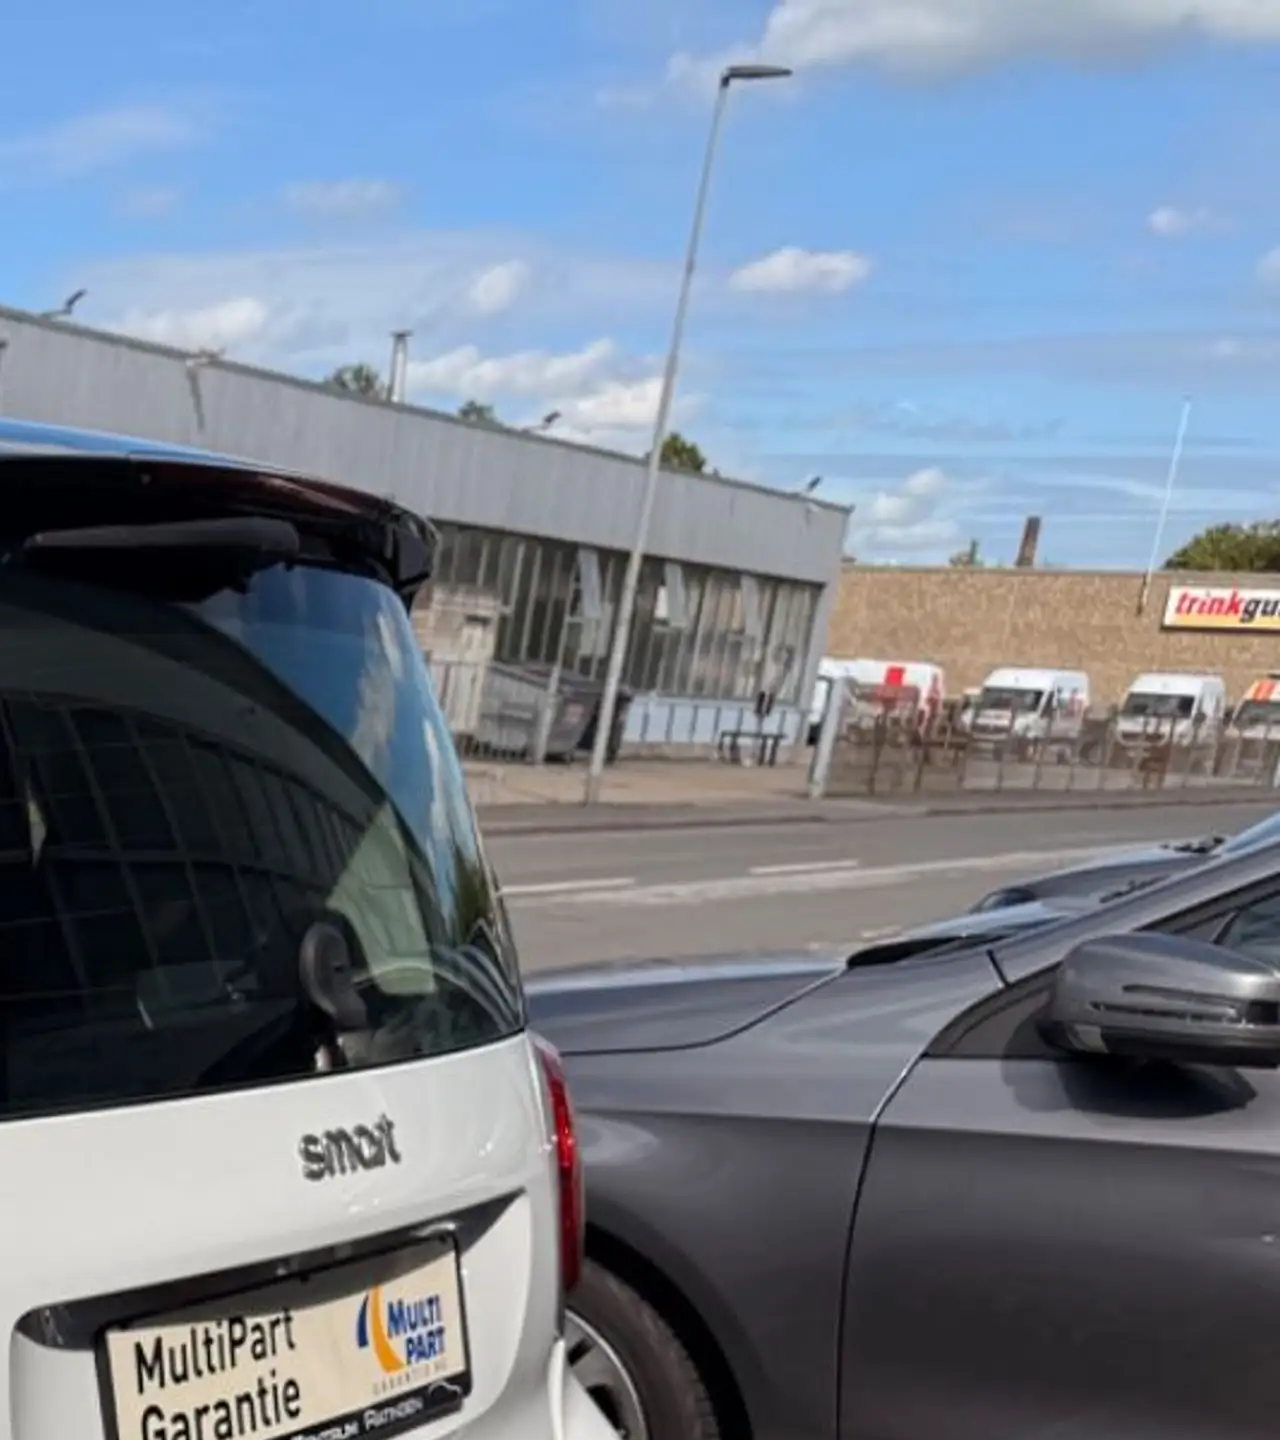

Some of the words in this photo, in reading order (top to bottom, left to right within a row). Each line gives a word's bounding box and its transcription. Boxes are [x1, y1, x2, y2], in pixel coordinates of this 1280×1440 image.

[1175, 583, 1280, 623] trinkgu
[299, 1112, 401, 1181] smart
[387, 1294, 441, 1339] MULTI
[134, 1308, 296, 1395] MultiPart
[405, 1326, 445, 1365] PART
